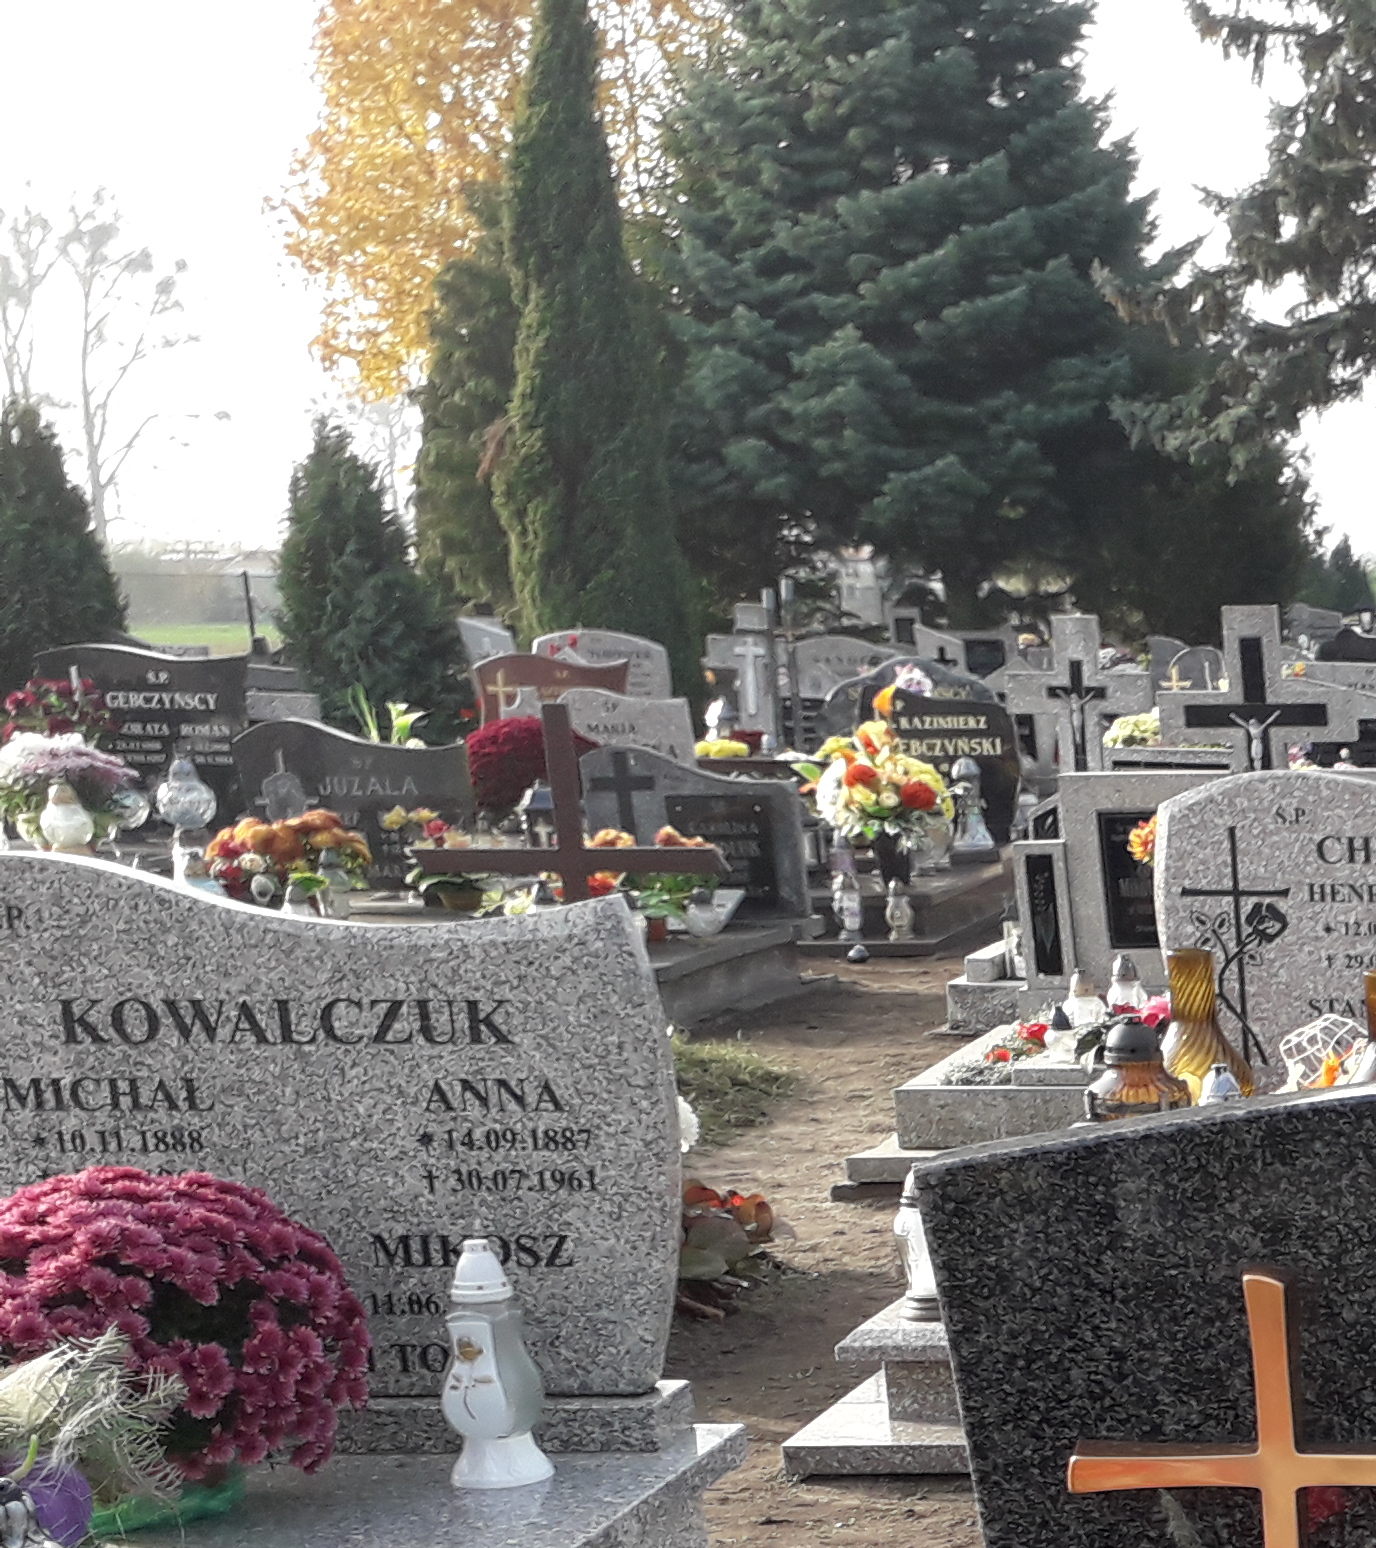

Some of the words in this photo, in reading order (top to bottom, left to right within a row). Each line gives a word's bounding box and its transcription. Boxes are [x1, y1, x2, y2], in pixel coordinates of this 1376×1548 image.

[899, 714, 988, 730] KAZIMIERZ
[58, 997, 518, 1047] KOWALCZUK
[2, 1076, 216, 1112] MICHAŁ
[423, 1078, 566, 1114] ANNA
